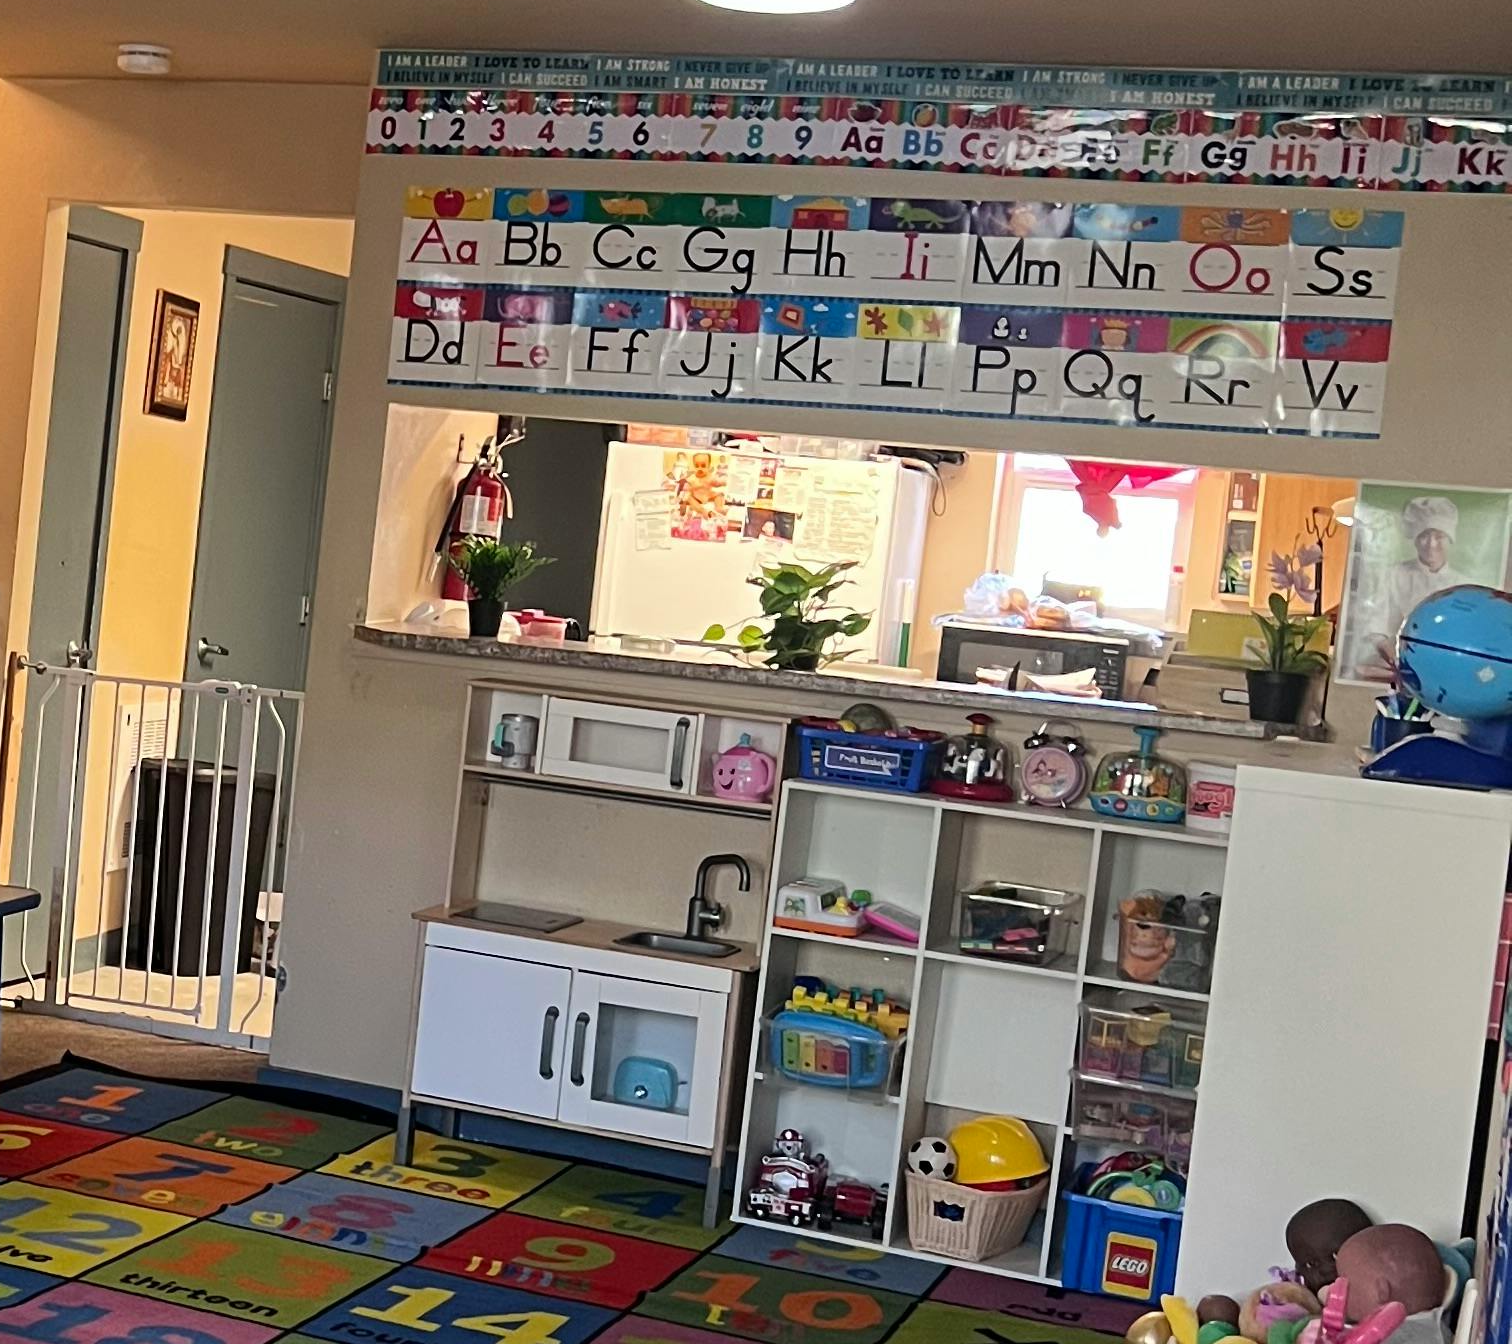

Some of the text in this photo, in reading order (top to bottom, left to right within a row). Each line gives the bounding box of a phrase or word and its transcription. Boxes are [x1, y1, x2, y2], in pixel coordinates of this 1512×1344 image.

[387, 56, 392, 67] I
[395, 57, 413, 67] AM
[415, 57, 422, 67] A
[424, 57, 468, 68] LEADER
[475, 58, 480, 68] I
[484, 58, 518, 68] LOVE
[523, 58, 540, 69] TO
[596, 59, 601, 70] I
[605, 59, 622, 71] AM
[626, 59, 670, 71] STRONG
[509, 72, 532, 85] CAN
[536, 72, 587, 86] SUCCEED
[674, 77, 679, 88] I
[685, 77, 704, 89] AM
[710, 78, 768, 91] HONEST
[381, 117, 397, 140] 0
[449, 117, 466, 142] 2
[489, 118, 506, 142] 3
[538, 120, 555, 143] 4
[589, 121, 603, 144] 5
[632, 122, 649, 146] 6
[700, 124, 717, 147] 7
[747, 125, 764, 148] 8
[795, 126, 812, 149] 9
[842, 128, 883, 154] Aa
[903, 130, 943, 156] Bb
[1143, 140, 1173, 166] Ff
[1201, 141, 1248, 170] Gg
[1270, 144, 1317, 172] Hh
[1342, 147, 1366, 174] Ii
[1392, 147, 1421, 176] Jj
[1458, 147, 1505, 176] Kk
[411, 219, 1373, 297] Aa Bb Cc Gg Hh Ii Mm Nn Oo Ss
[405, 319, 1358, 422] Dd Ee Ff Jj Kk Ll Pp Qq Rr Vv
[58, 1085, 144, 1112] 1
[192, 1130, 284, 1158] two
[230, 1111, 322, 1143] 2
[414, 1145, 501, 1179] 3
[309, 1194, 413, 1229] 8
[140, 1237, 351, 1300] 13
[525, 1236, 615, 1272] 9
[1111, 1255, 1148, 1276] LEGO
[120, 1272, 279, 1319] thirteen
[674, 1270, 884, 1329] 10
